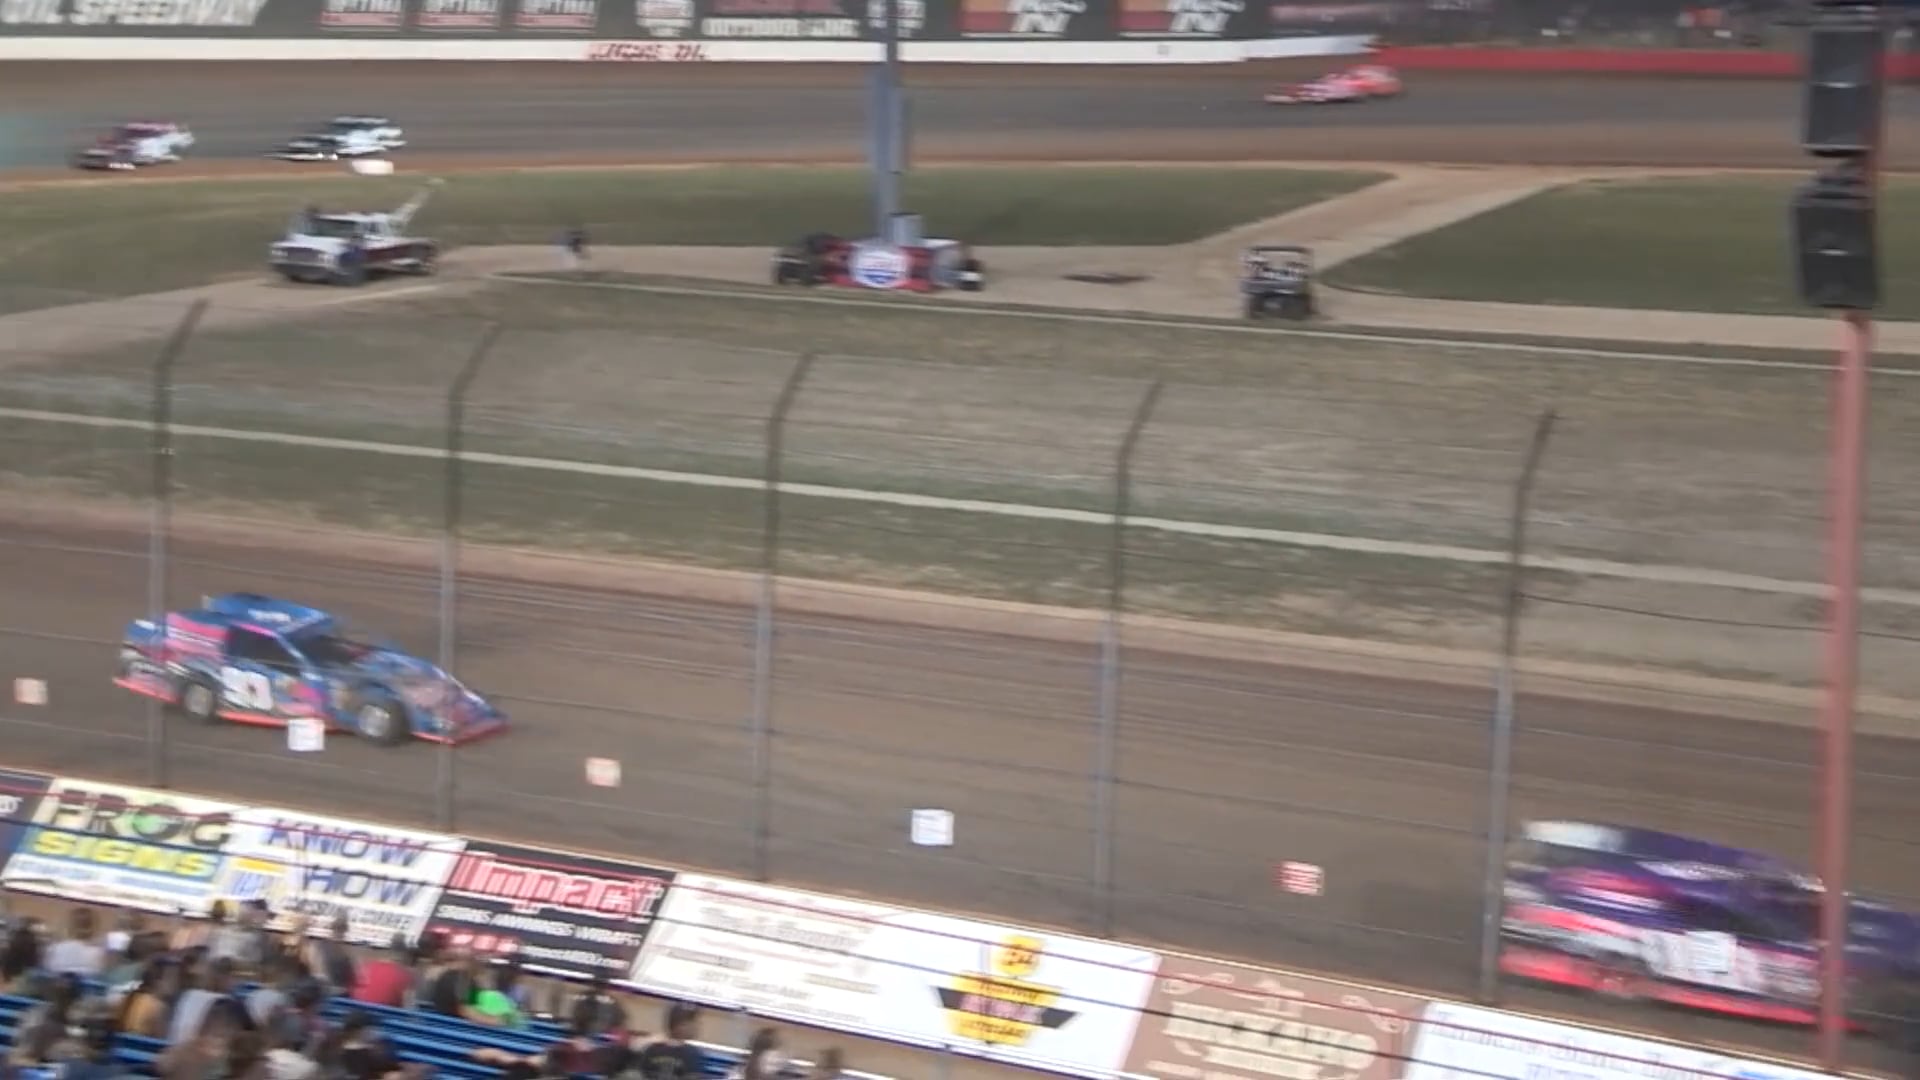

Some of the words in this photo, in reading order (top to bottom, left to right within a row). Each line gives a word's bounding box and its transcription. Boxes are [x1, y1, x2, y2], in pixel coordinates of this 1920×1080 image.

[52, 788, 232, 847] FROG
[264, 817, 431, 867] KNOW
[33, 829, 219, 878] SIGNS
[302, 864, 430, 907] HOW
[448, 850, 666, 924] Impact
